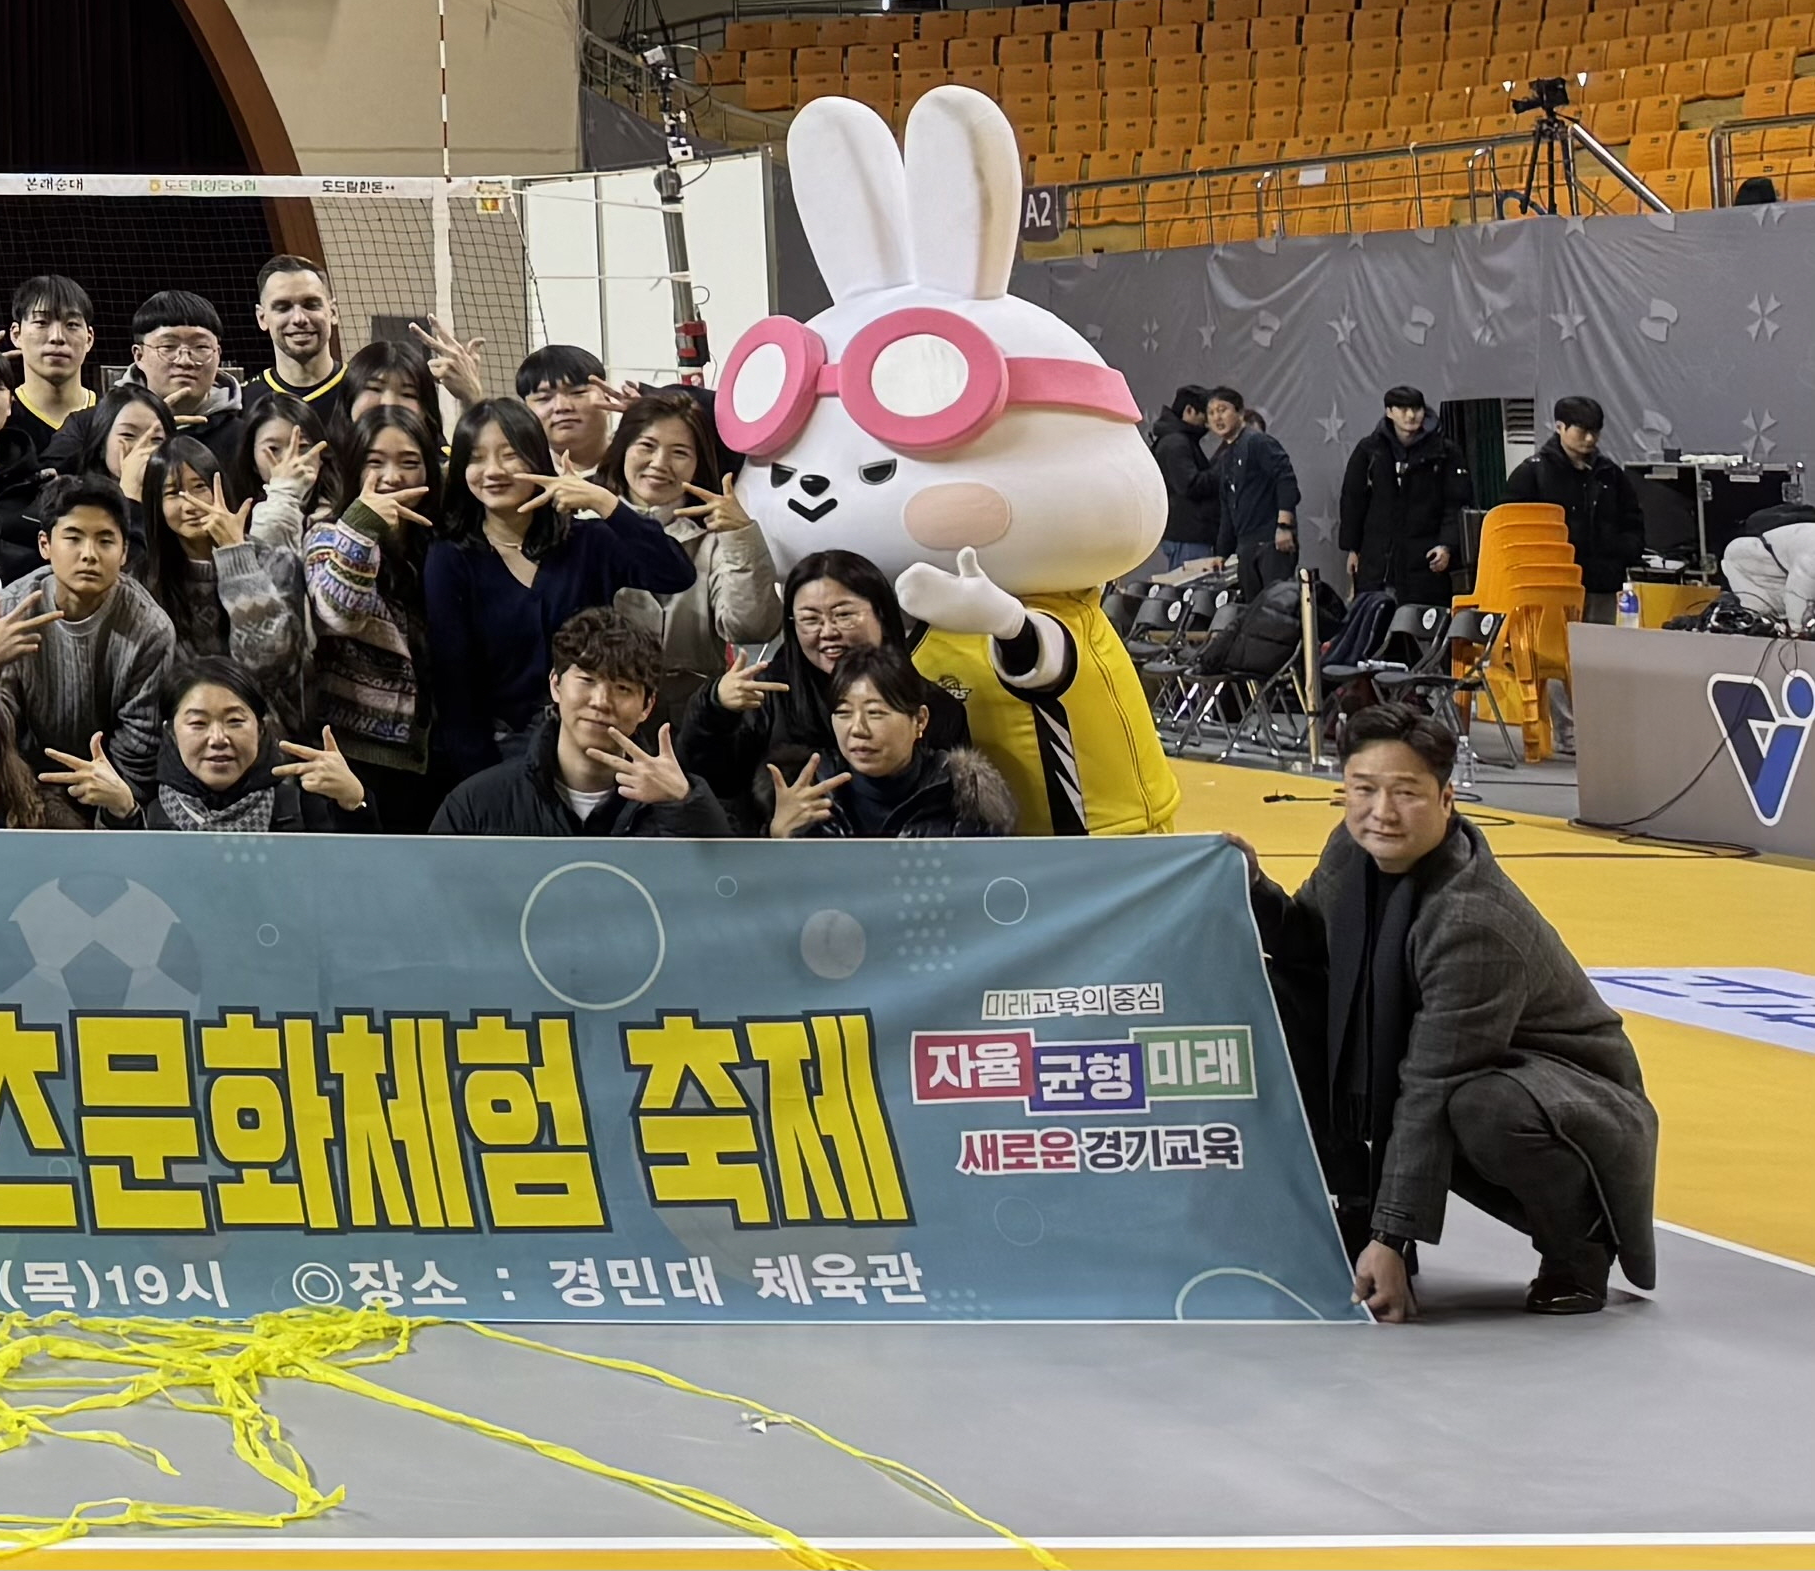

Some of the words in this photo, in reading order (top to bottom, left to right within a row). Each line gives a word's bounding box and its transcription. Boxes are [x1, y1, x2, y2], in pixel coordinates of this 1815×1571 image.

[322, 180, 383, 194] 도드람한돈
[1024, 191, 1051, 228] A2
[983, 985, 1108, 1020] 미래교육의
[1110, 983, 1164, 1016] 중심
[927, 1042, 1023, 1091] 자율
[1038, 1052, 1134, 1104] 균형
[1148, 1037, 1241, 1087] 미래
[620, 1006, 916, 1230] 축제
[957, 1127, 1077, 1175] 새로운
[1078, 1124, 1244, 1172] 경기교육
[347, 1260, 469, 1310] 장소
[549, 1256, 718, 1310] 경민대
[751, 1252, 927, 1306] 체육관
